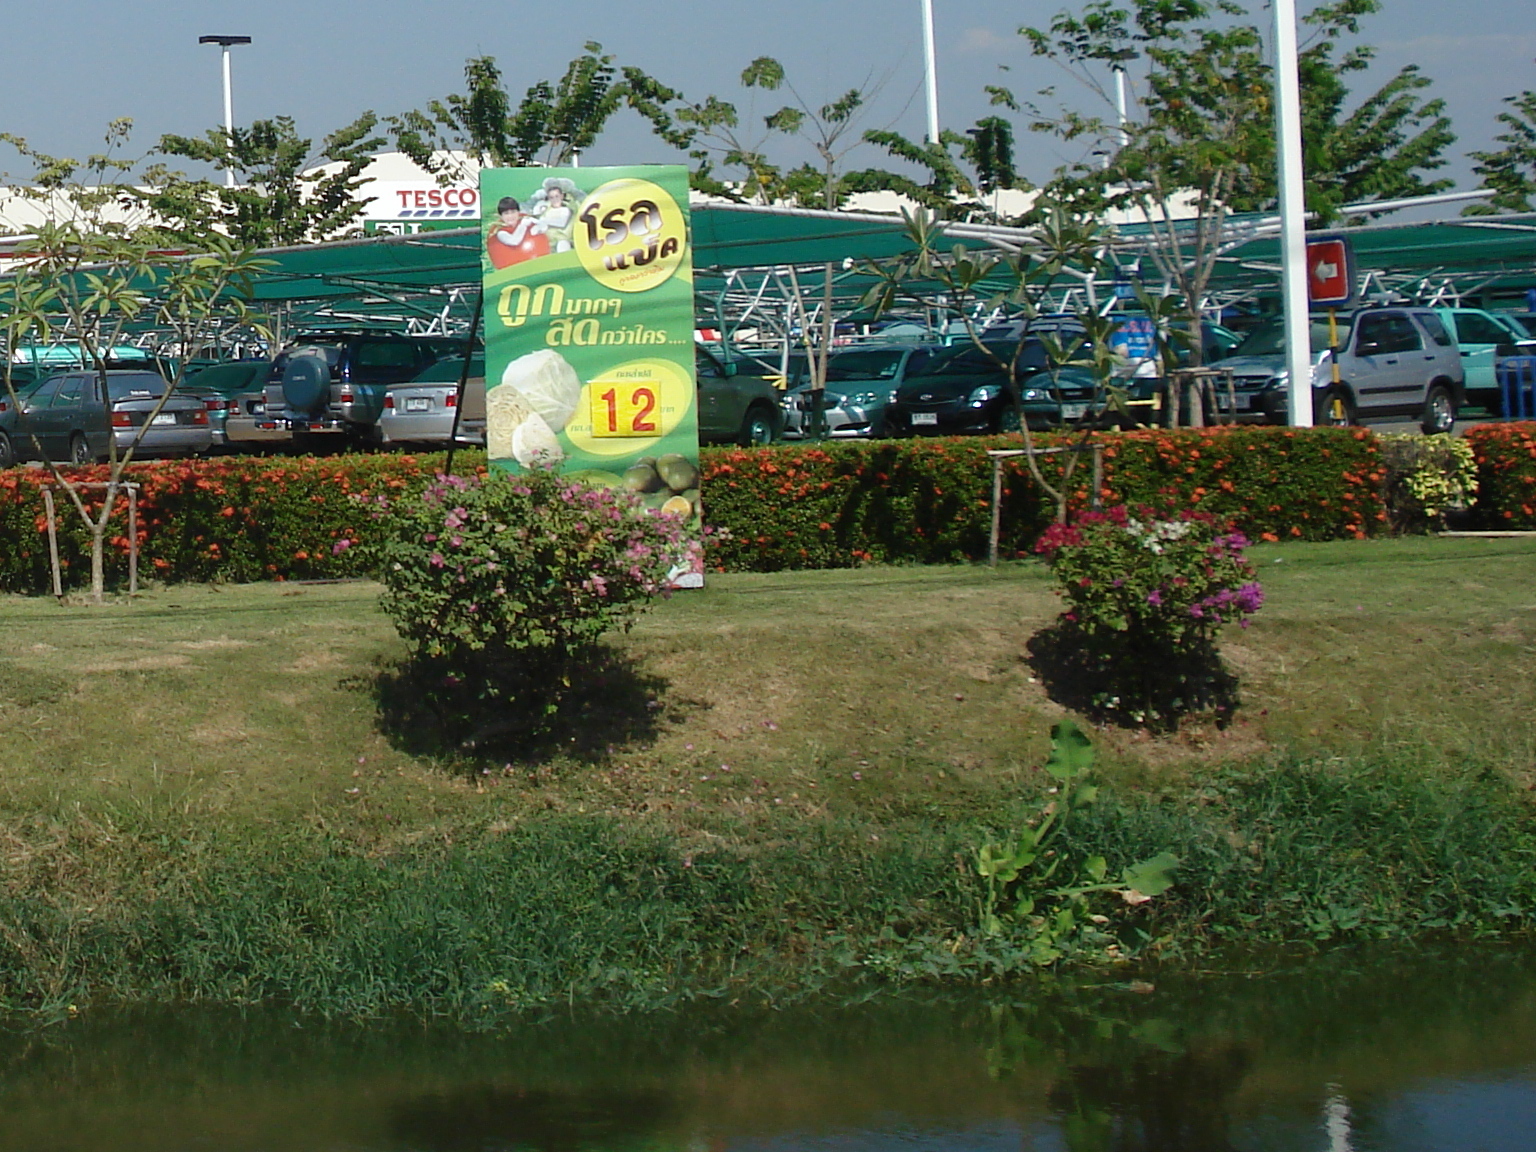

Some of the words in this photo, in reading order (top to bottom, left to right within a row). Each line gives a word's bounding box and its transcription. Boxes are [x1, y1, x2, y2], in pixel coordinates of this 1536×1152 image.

[396, 188, 477, 209] TESCO
[579, 199, 663, 251] โรล
[497, 283, 565, 327] ถูก
[566, 298, 622, 318] มากๆ
[545, 317, 600, 346] สด
[601, 388, 656, 432] 12
